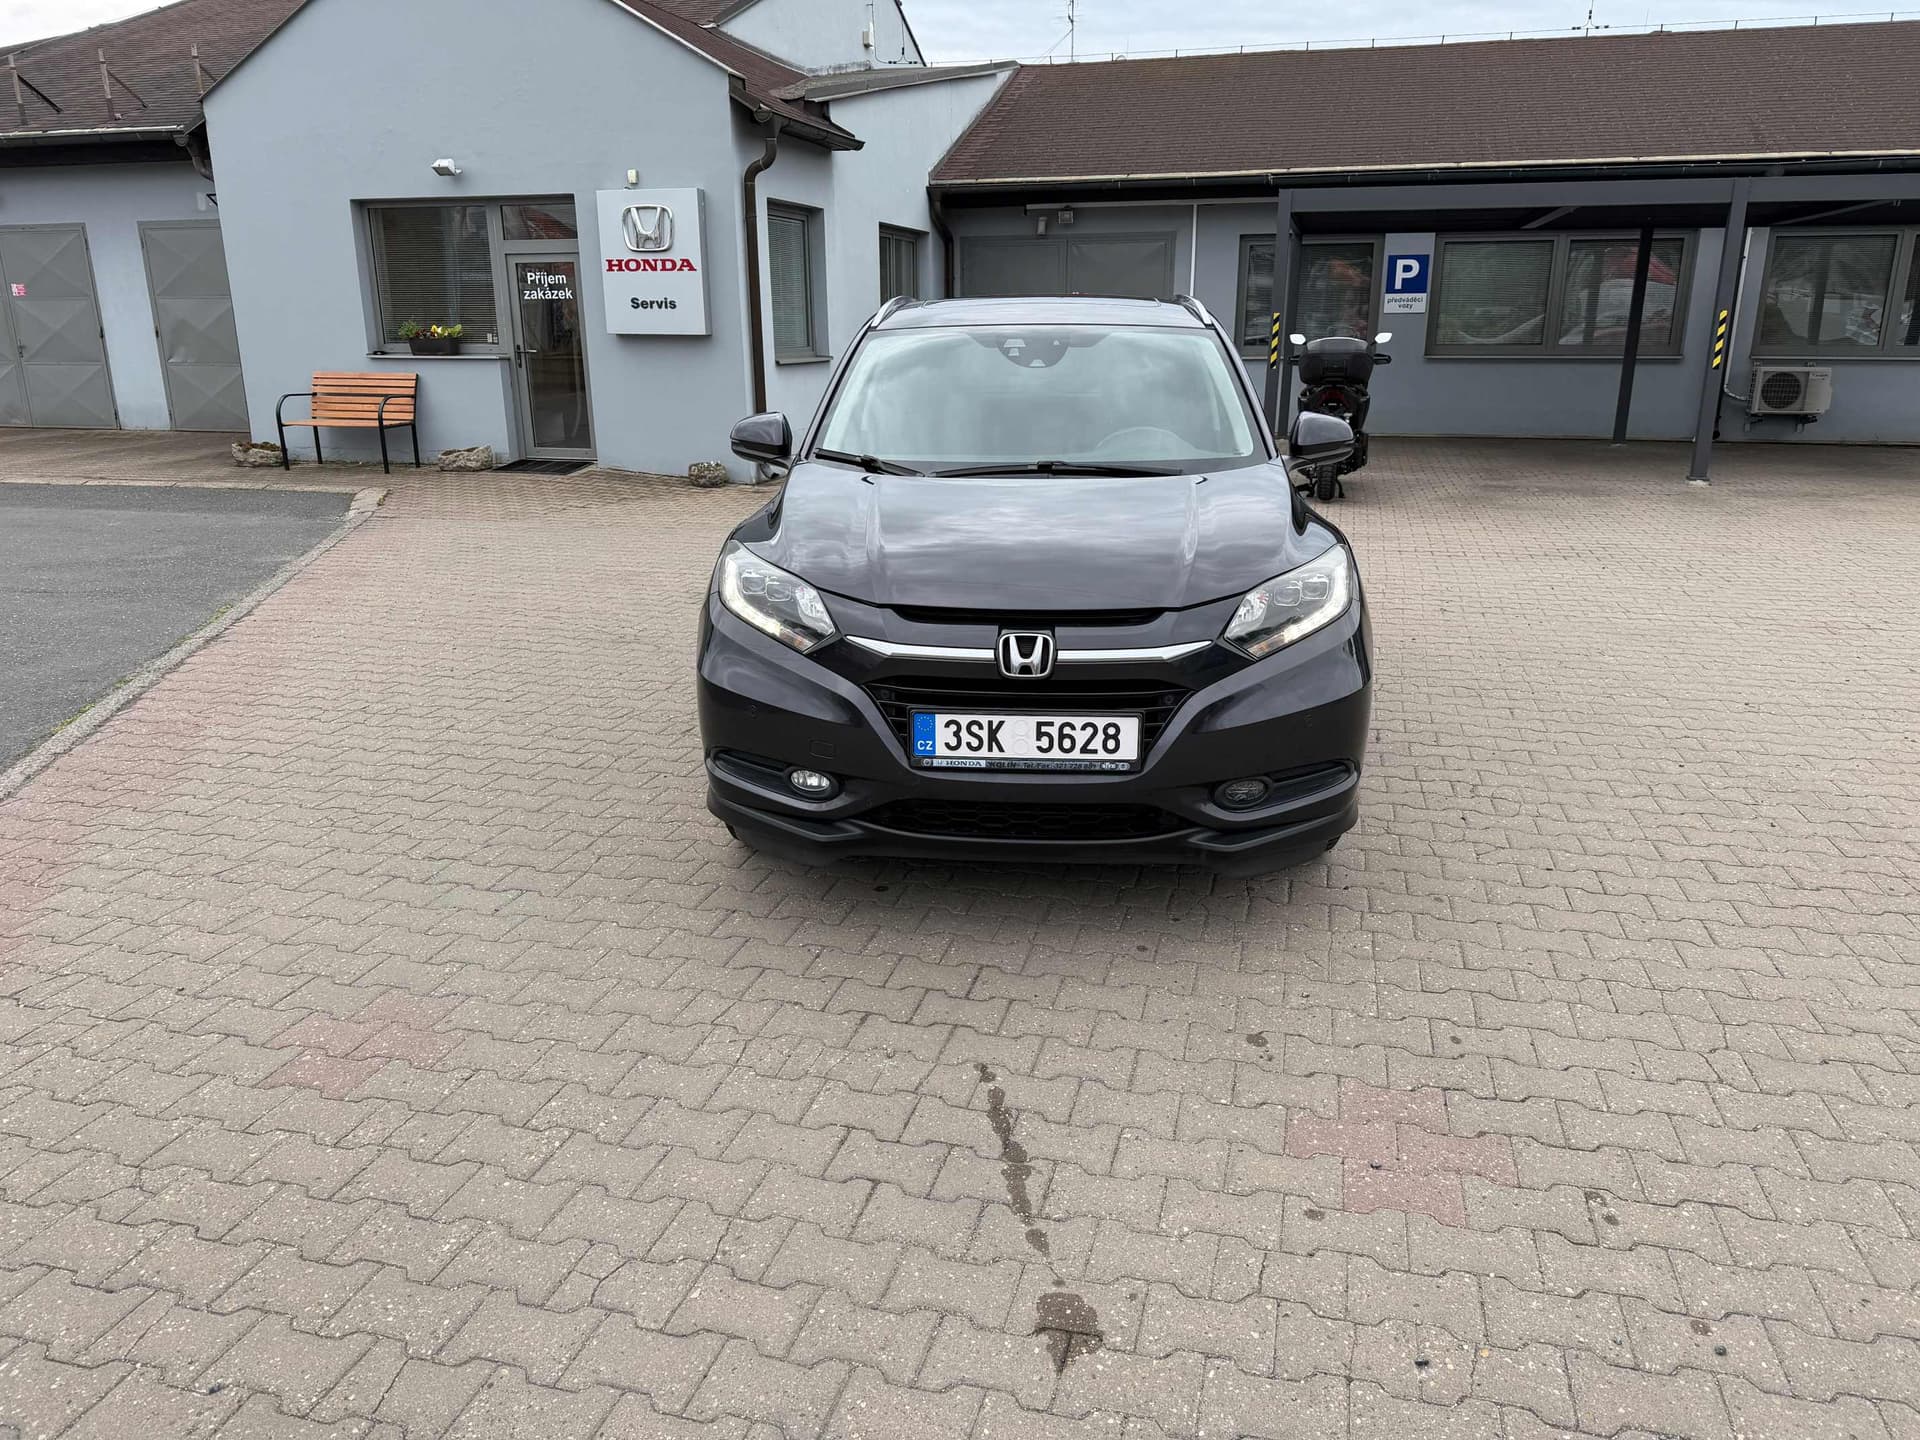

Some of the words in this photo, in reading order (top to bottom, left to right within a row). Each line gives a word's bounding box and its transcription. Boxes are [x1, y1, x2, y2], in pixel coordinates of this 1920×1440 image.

[606, 258, 697, 273] HONDA
[527, 271, 567, 287] Příjem
[1394, 258, 1420, 290] P
[523, 287, 573, 300] zakázek
[630, 297, 677, 310] Servis
[943, 719, 1006, 753] 3SK
[1035, 721, 1121, 755] 5628
[917, 741, 933, 750] CZ
[945, 760, 982, 768] HONDA
